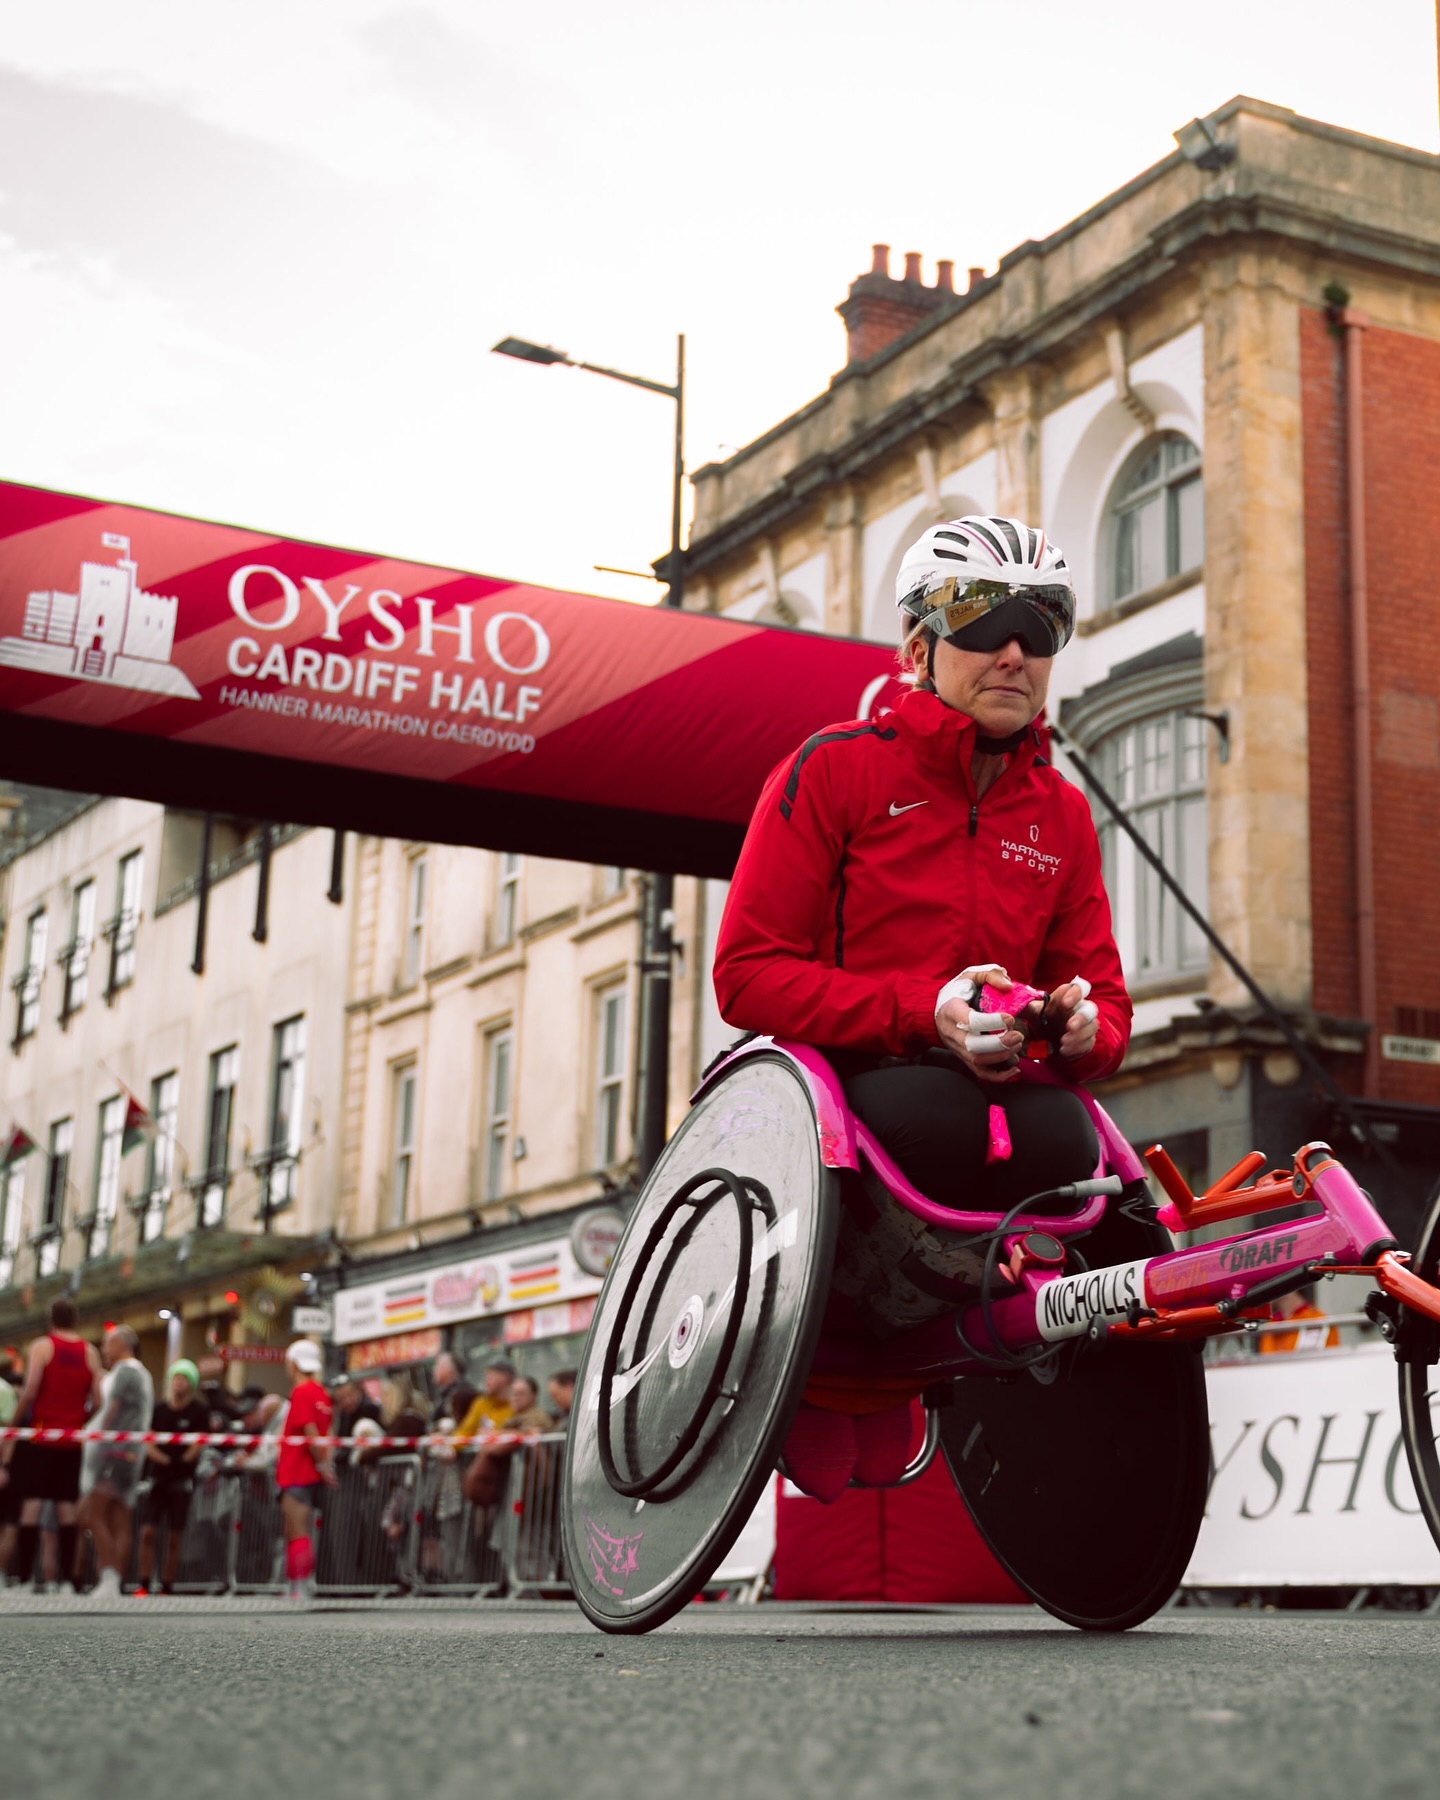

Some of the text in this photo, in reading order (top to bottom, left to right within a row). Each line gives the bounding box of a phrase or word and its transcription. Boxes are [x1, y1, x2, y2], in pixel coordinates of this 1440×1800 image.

[228, 564, 550, 675] OYSHO
[227, 637, 543, 723] CARDIFF HALF
[219, 686, 536, 754] HANNER MARATHON CAERDYDD
[1001, 839, 1062, 866] HARTPURY
[1002, 850, 1058, 876] SPORT
[1230, 1234, 1298, 1273] DRAFT
[1044, 1266, 1136, 1329] NICHOLLS
[1203, 1409, 1422, 1521] YSH
